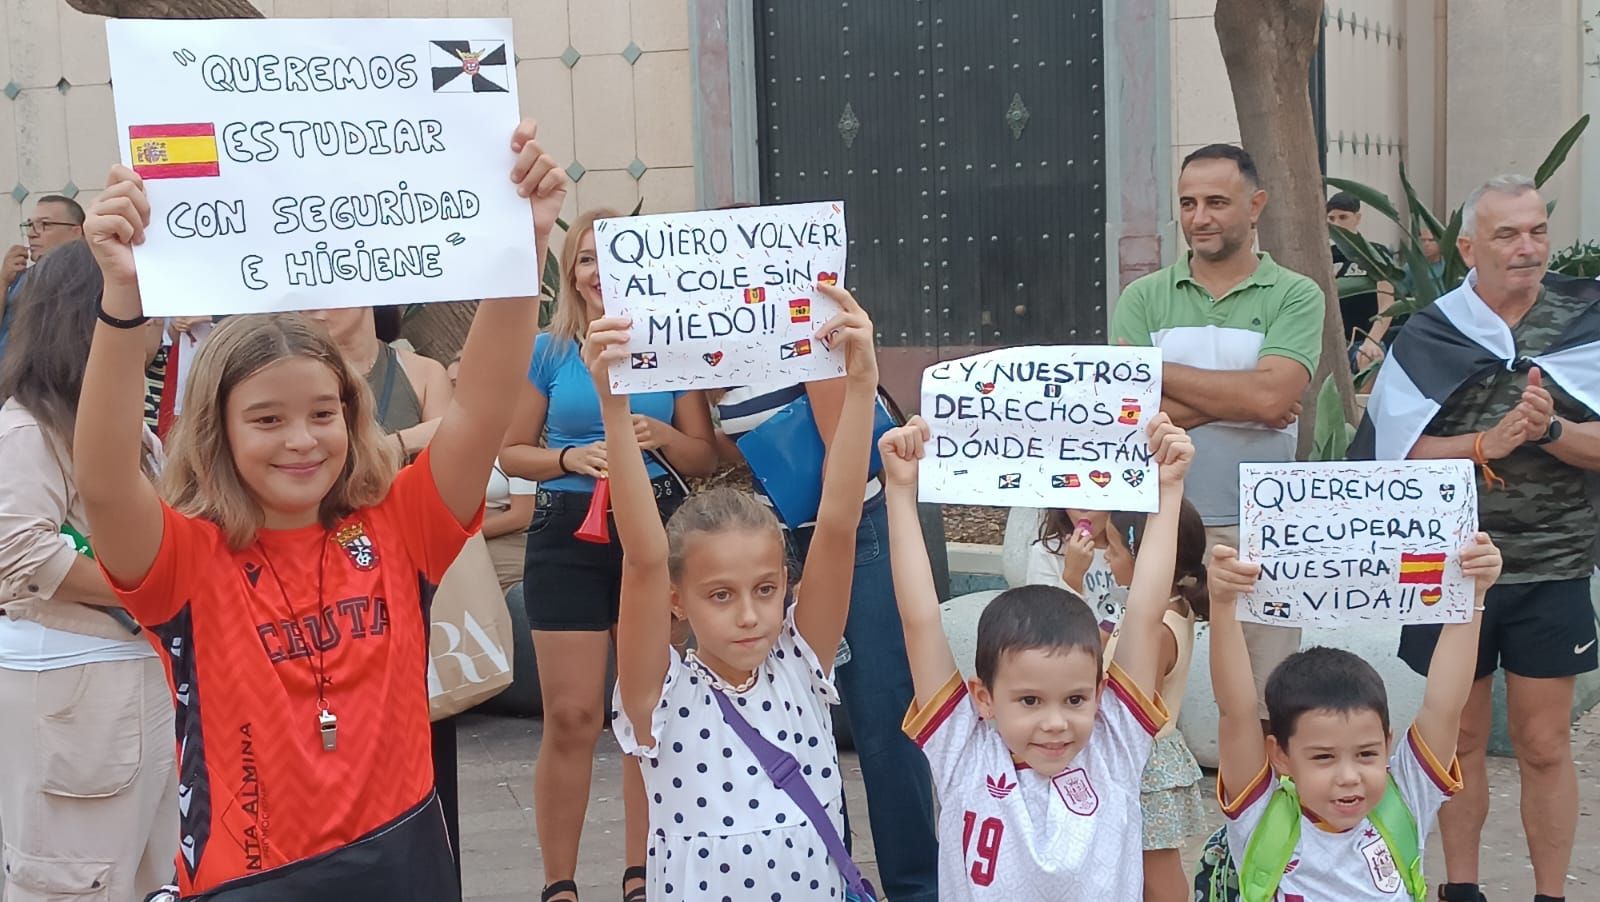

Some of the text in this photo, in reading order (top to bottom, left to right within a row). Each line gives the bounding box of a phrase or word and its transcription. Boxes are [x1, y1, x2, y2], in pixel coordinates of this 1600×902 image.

[222, 119, 446, 162] ESTUDIAR
[166, 200, 246, 238] CON
[737, 222, 842, 249] VOLVER
[241, 255, 268, 290] E
[625, 274, 667, 297] AL
[677, 267, 750, 292] COLE
[993, 361, 1151, 385] NUESTROS
[934, 393, 1115, 426] DERECHOS
[936, 428, 1044, 459] DÓNDE
[1253, 477, 1423, 512] QUEREMOS
[1261, 518, 1446, 550] RECUPERAR
[1257, 559, 1391, 581] NUESTRA
[240, 722, 262, 870] NTA ALMINA
[962, 810, 1004, 887] 19
